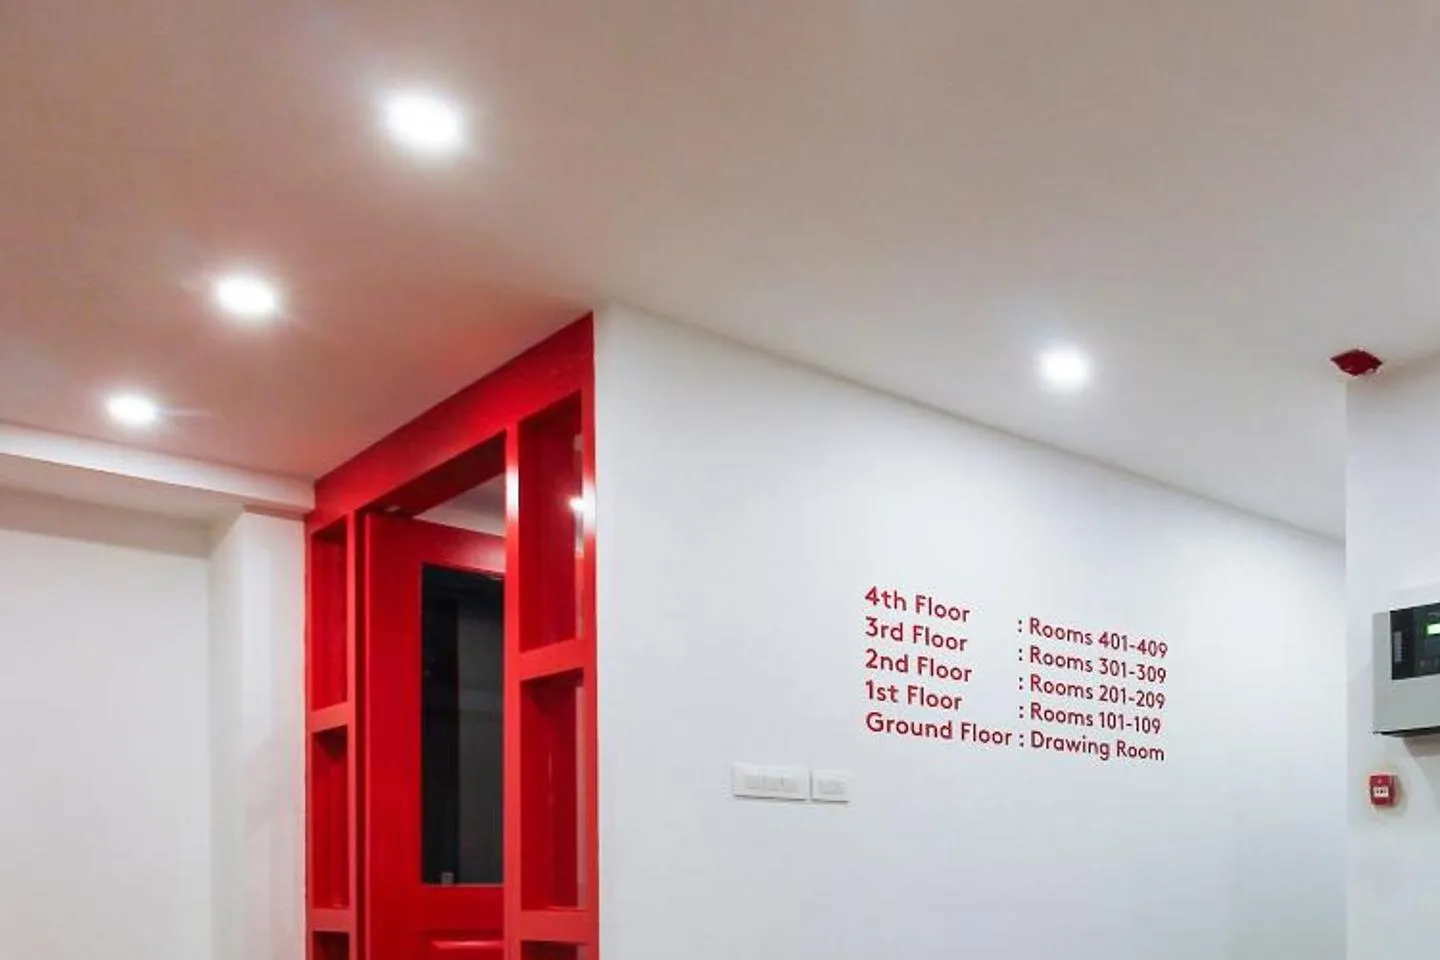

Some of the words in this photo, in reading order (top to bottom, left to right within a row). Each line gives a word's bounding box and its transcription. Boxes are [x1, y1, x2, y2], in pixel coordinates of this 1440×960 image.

[865, 586, 907, 611] 4th
[914, 595, 970, 622] Floor
[1029, 617, 1093, 646] Rooms
[1098, 631, 1169, 659] 401-409
[865, 616, 904, 643] 3rd
[912, 625, 968, 651] Floor
[1029, 645, 1093, 673] Rooms
[1098, 658, 1167, 685] 301-309
[865, 648, 908, 673] 2nd
[916, 656, 972, 682] Floor
[1029, 673, 1094, 701] Rooms
[1098, 684, 1166, 710] 201-209
[865, 680, 899, 703] 1st
[907, 685, 962, 711] Floor
[1030, 702, 1094, 727] Rooms
[1098, 712, 1161, 735] 101-109
[865, 712, 953, 740] Ground
[960, 722, 1012, 746] Floor
[1030, 730, 1110, 761] Drawing
[1116, 740, 1165, 761] Room
